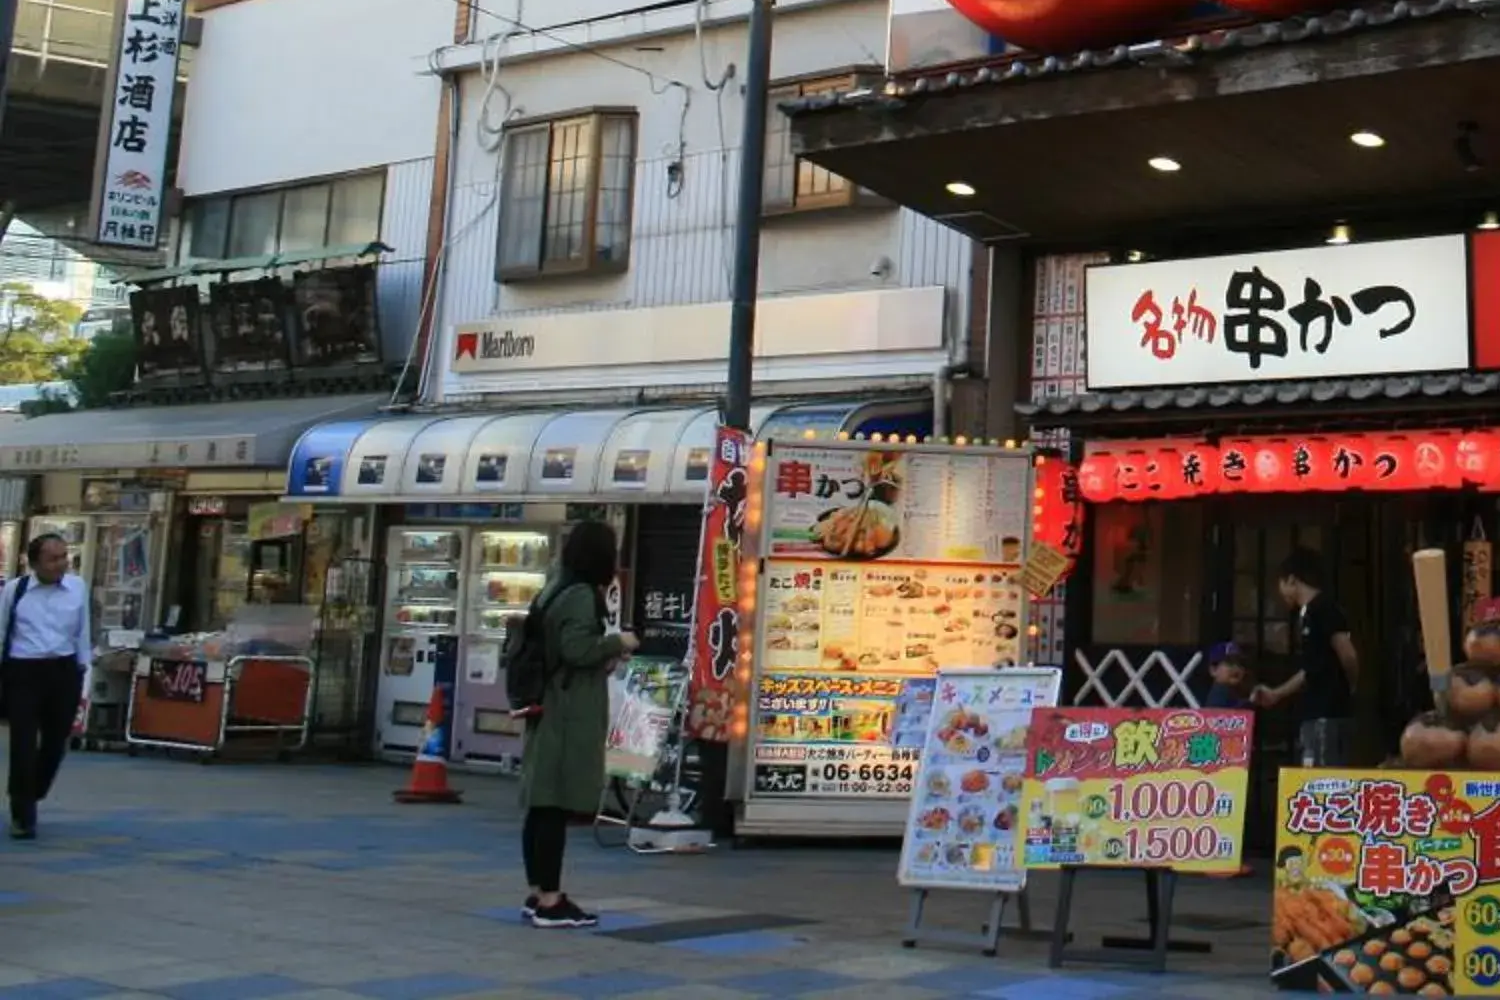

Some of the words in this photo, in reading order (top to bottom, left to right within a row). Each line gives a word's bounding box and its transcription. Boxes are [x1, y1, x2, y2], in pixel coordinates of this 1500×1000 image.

[481, 330, 535, 358] Marlboro
[775, 460, 866, 498] 串かつ
[1288, 781, 1435, 835] たこ焼き
[1358, 843, 1477, 896] 串かつ
